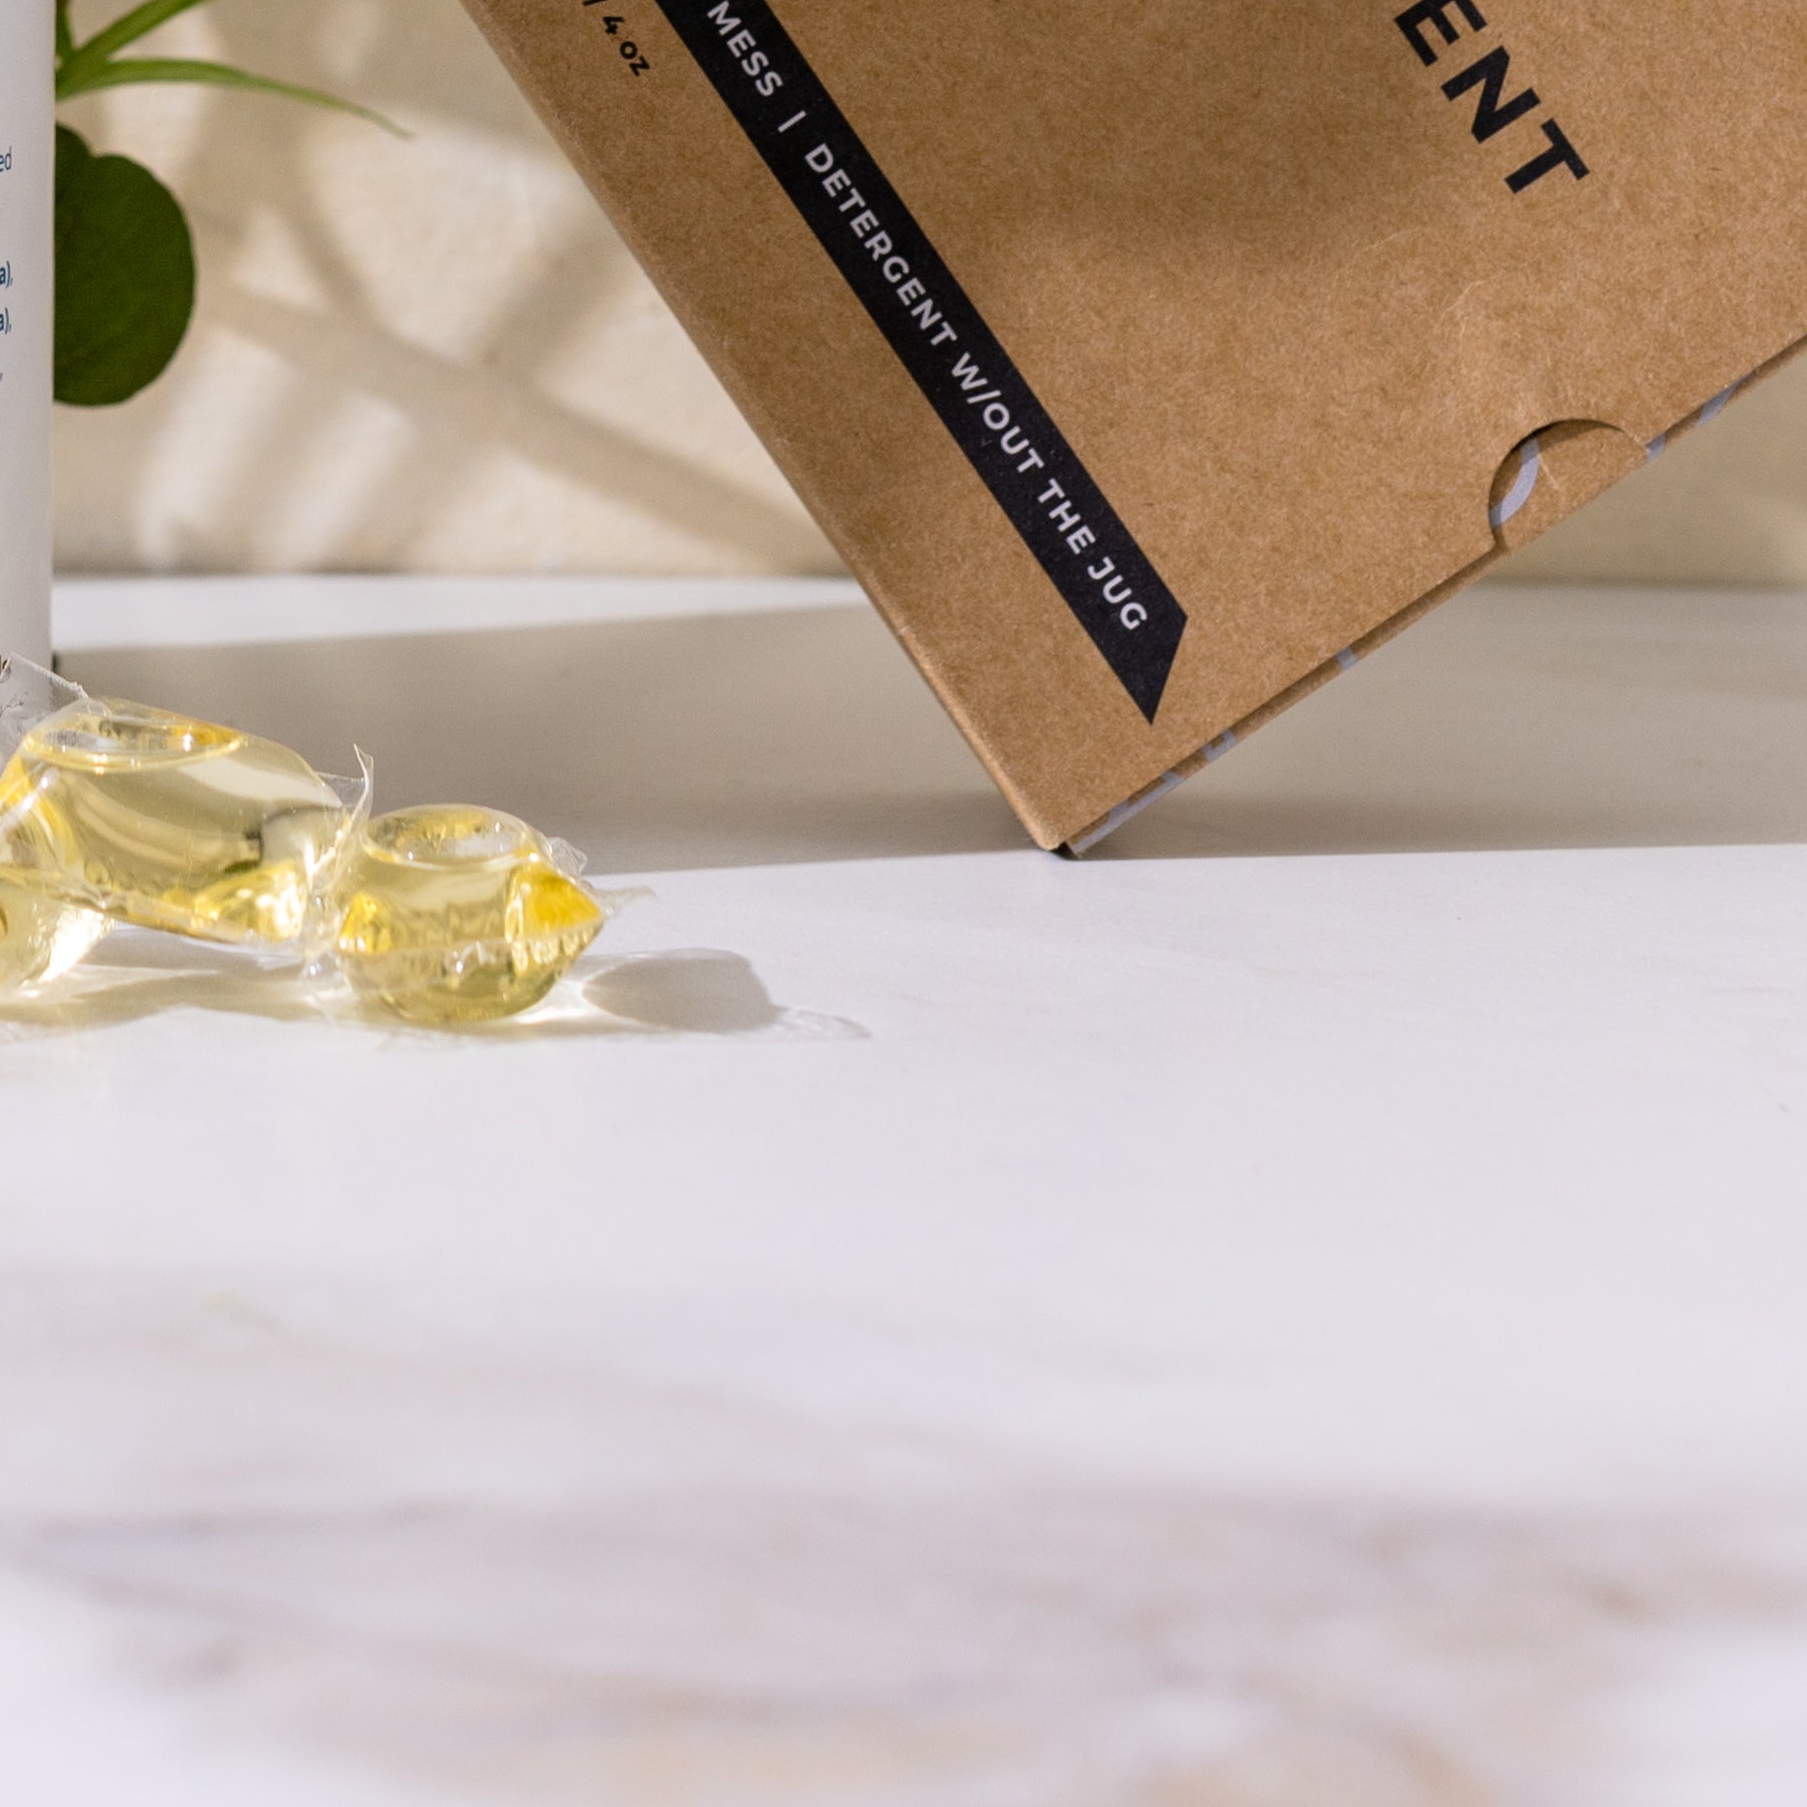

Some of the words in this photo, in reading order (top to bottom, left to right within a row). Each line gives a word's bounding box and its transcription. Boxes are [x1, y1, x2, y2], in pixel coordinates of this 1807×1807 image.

[602, 15, 625, 36] 4
[618, 40, 651, 77] oz
[707, 1, 783, 96] MESS
[805, 144, 957, 345] DETERGENT
[950, 352, 1044, 473] W/OUT
[1037, 478, 1096, 555] THE
[1087, 556, 1148, 630] JUG
